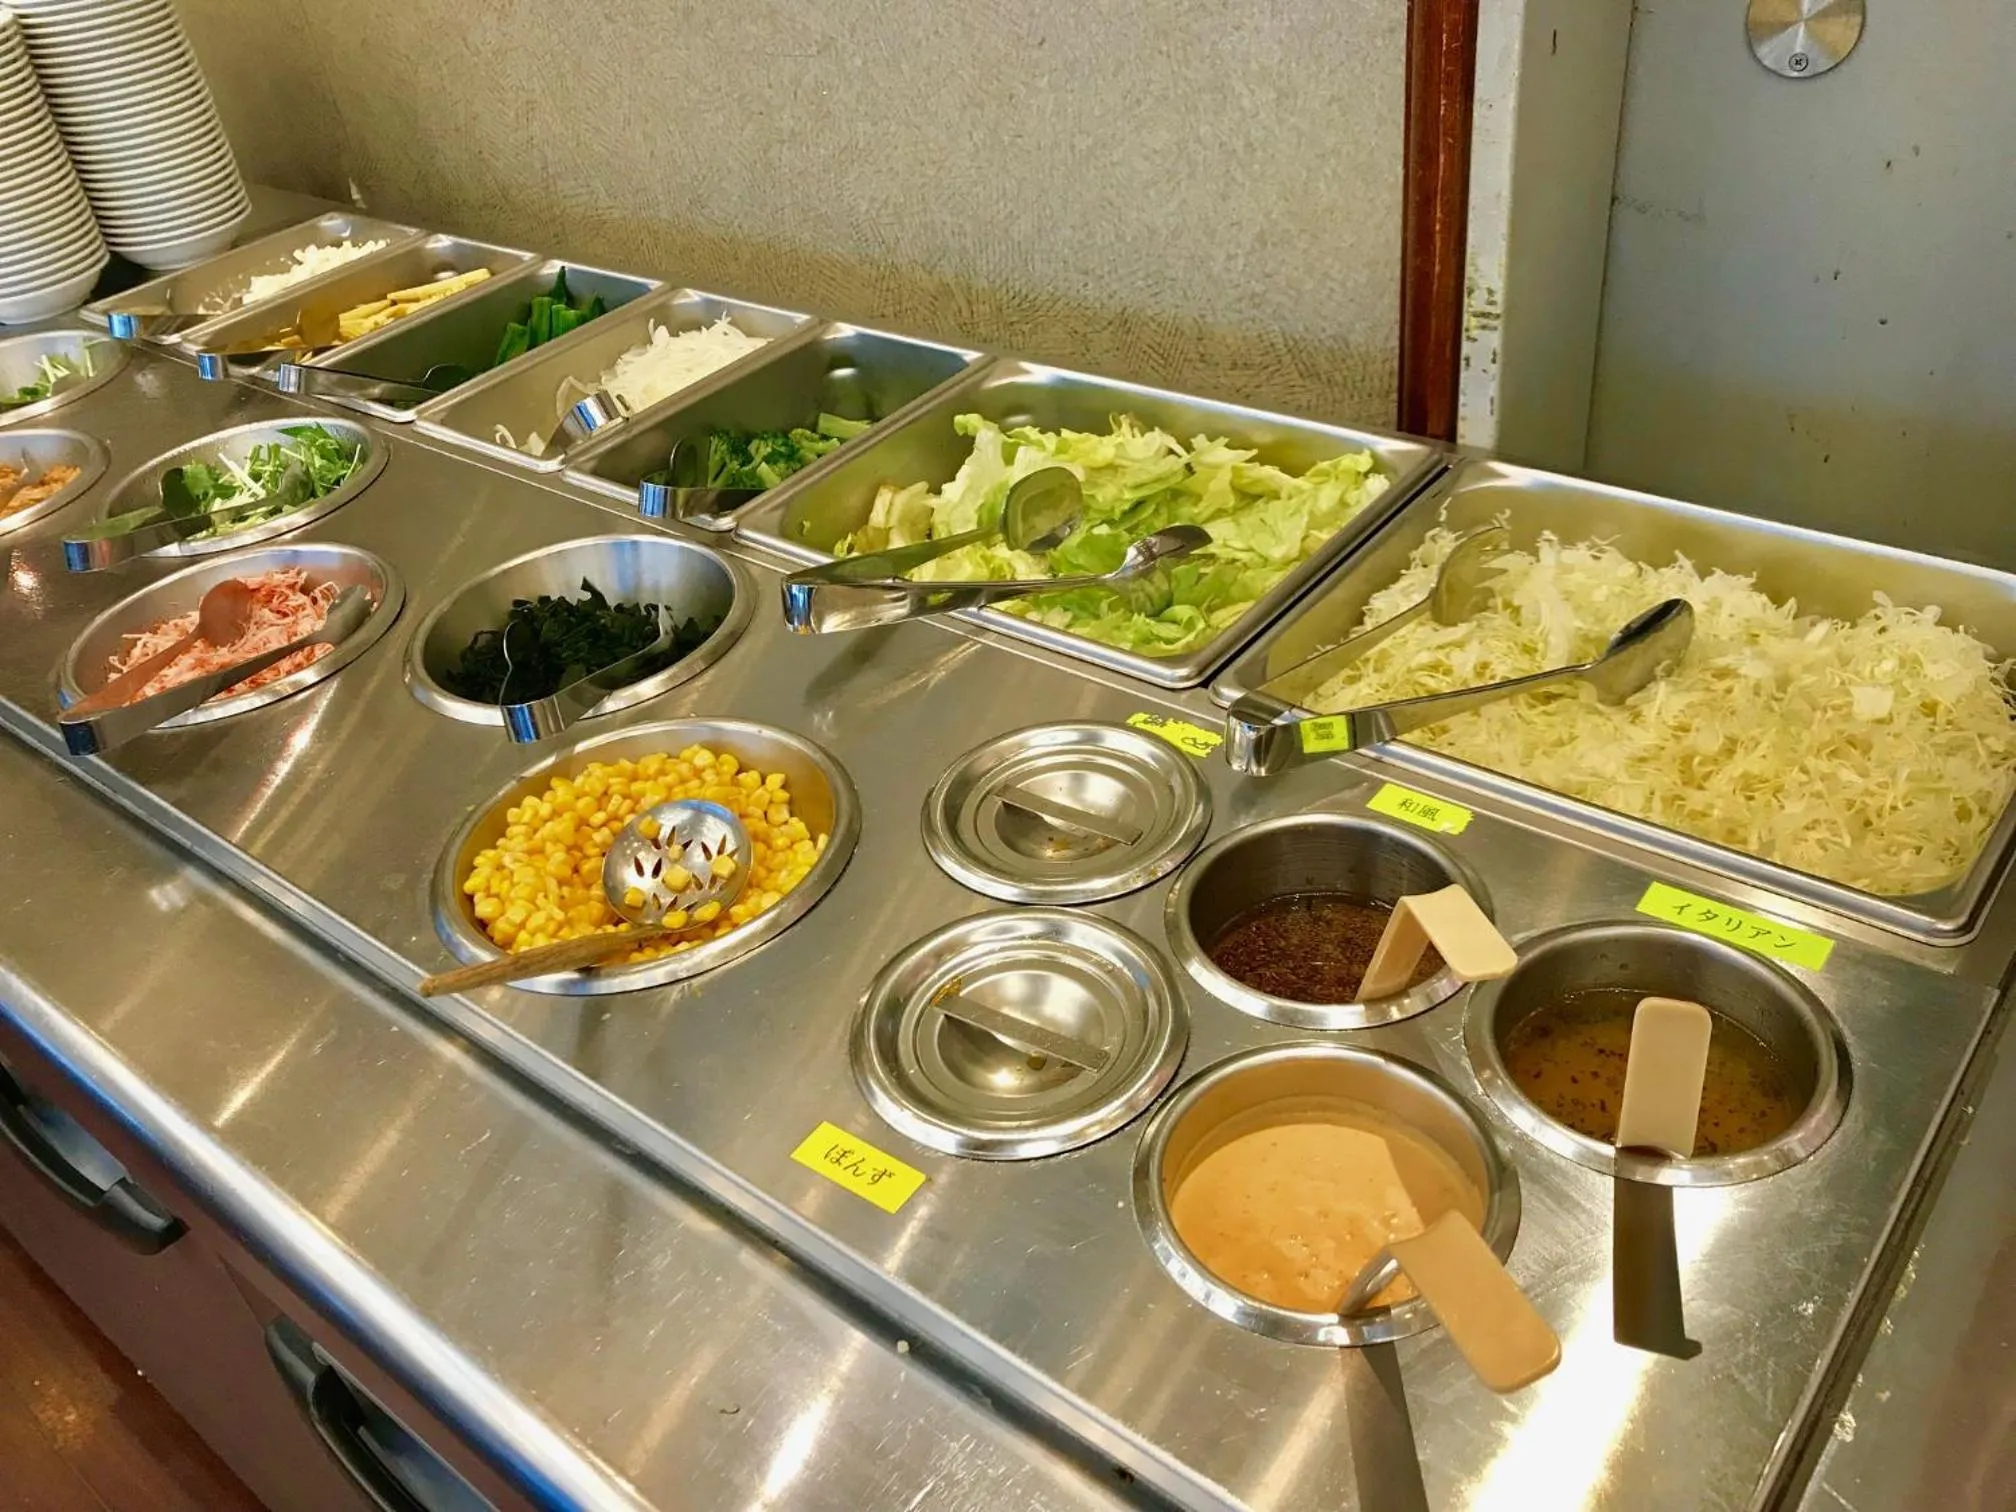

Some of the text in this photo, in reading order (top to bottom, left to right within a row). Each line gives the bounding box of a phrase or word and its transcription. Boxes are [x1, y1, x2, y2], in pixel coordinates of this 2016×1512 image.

[1397, 797, 1441, 822] 和風
[1672, 902, 1797, 949] イタリアン
